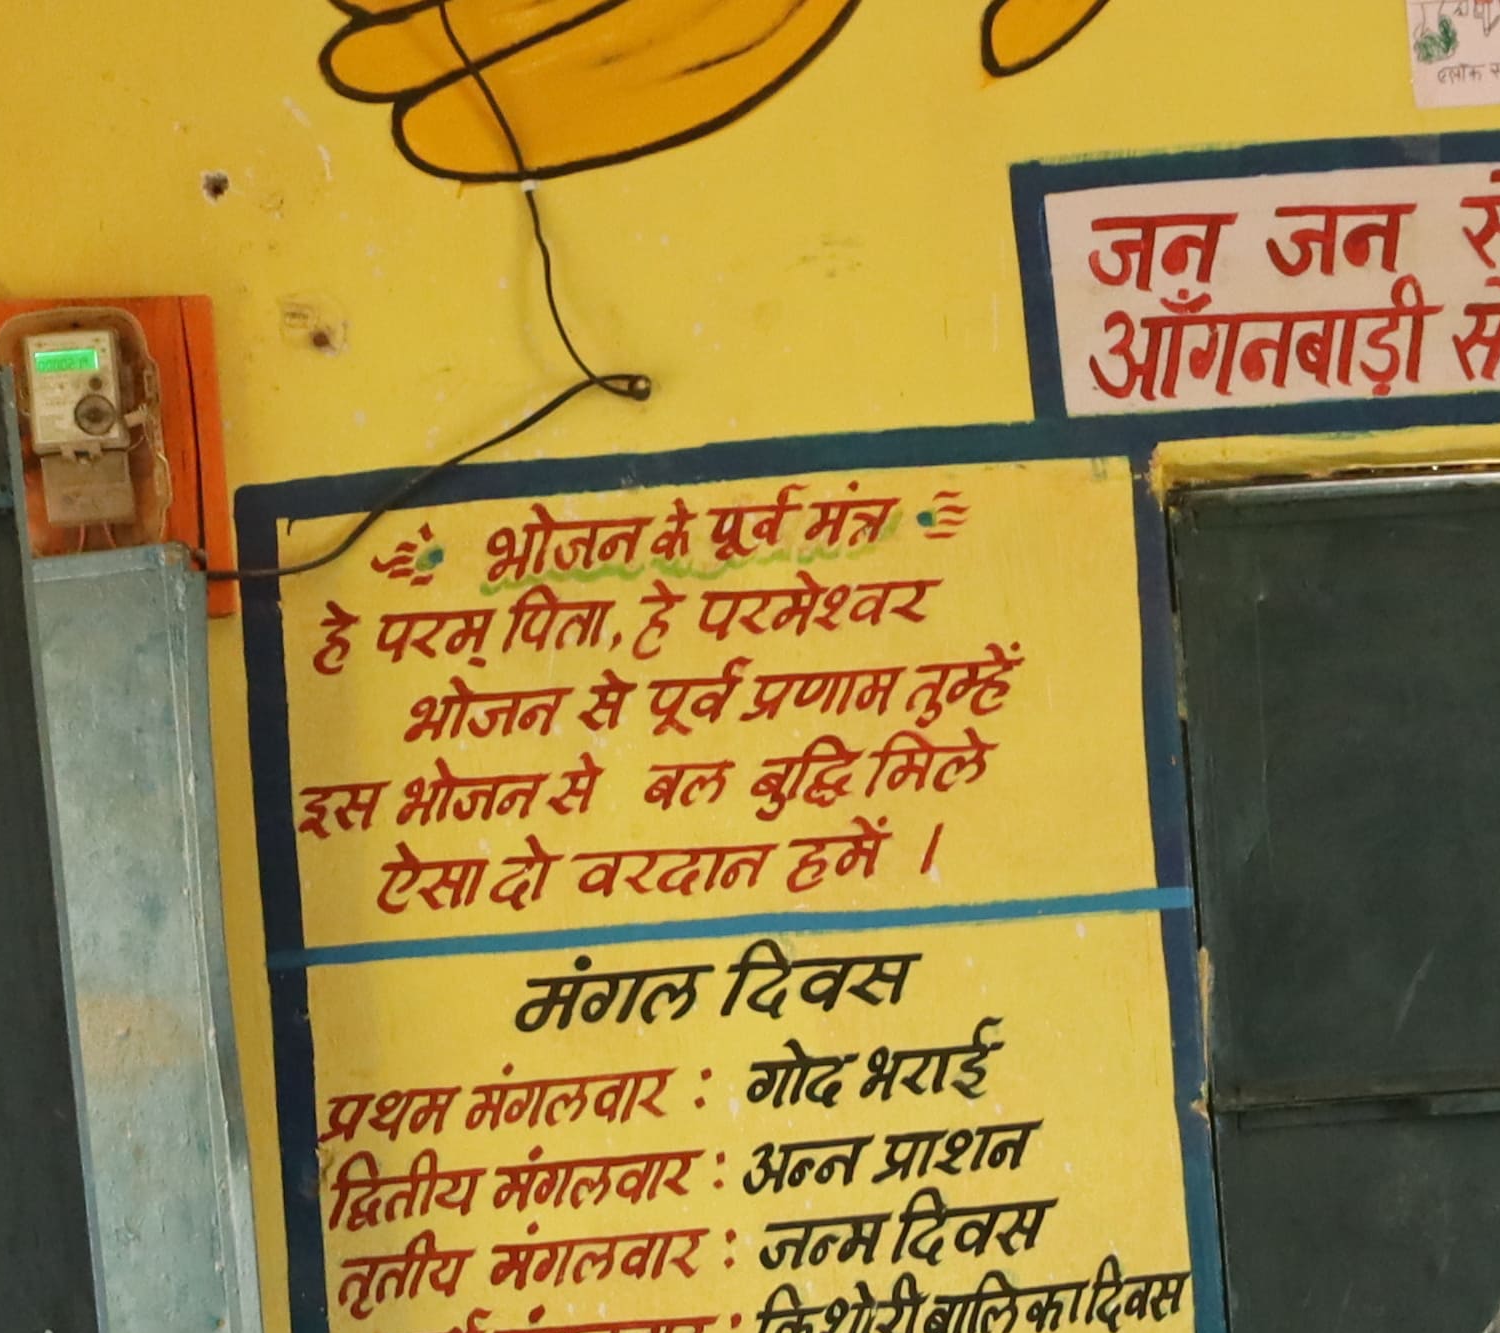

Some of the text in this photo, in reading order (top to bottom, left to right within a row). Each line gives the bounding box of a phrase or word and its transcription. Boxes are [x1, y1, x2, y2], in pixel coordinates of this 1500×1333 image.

[1089, 211, 1237, 291] जन
[1266, 202, 1417, 282] जन
[1089, 275, 1443, 399] आँगनबाड़ी
[485, 483, 901, 582] भोजन के पूर्व मंत्र
[313, 569, 942, 674] हे परम् पिता, हे परमेश्वर
[406, 643, 1024, 746] भोजन से पूर्व प्रणाम तुम्हें
[299, 728, 998, 838] इस भोजन से बल बुद्धि मिले
[378, 817, 890, 915] ऐसा दो वरदान हमें
[514, 940, 922, 1035] मंगल दिवस
[323, 1018, 1004, 1144] प्रथम मंगलवार गोद भराई
[328, 1118, 1044, 1232] द्वितीय मंगलवार अन्न प्राशन
[337, 1187, 1059, 1319] तृतीय मंगलवार जन्म दिवस
[1084, 1258, 1191, 1328] दिवस
